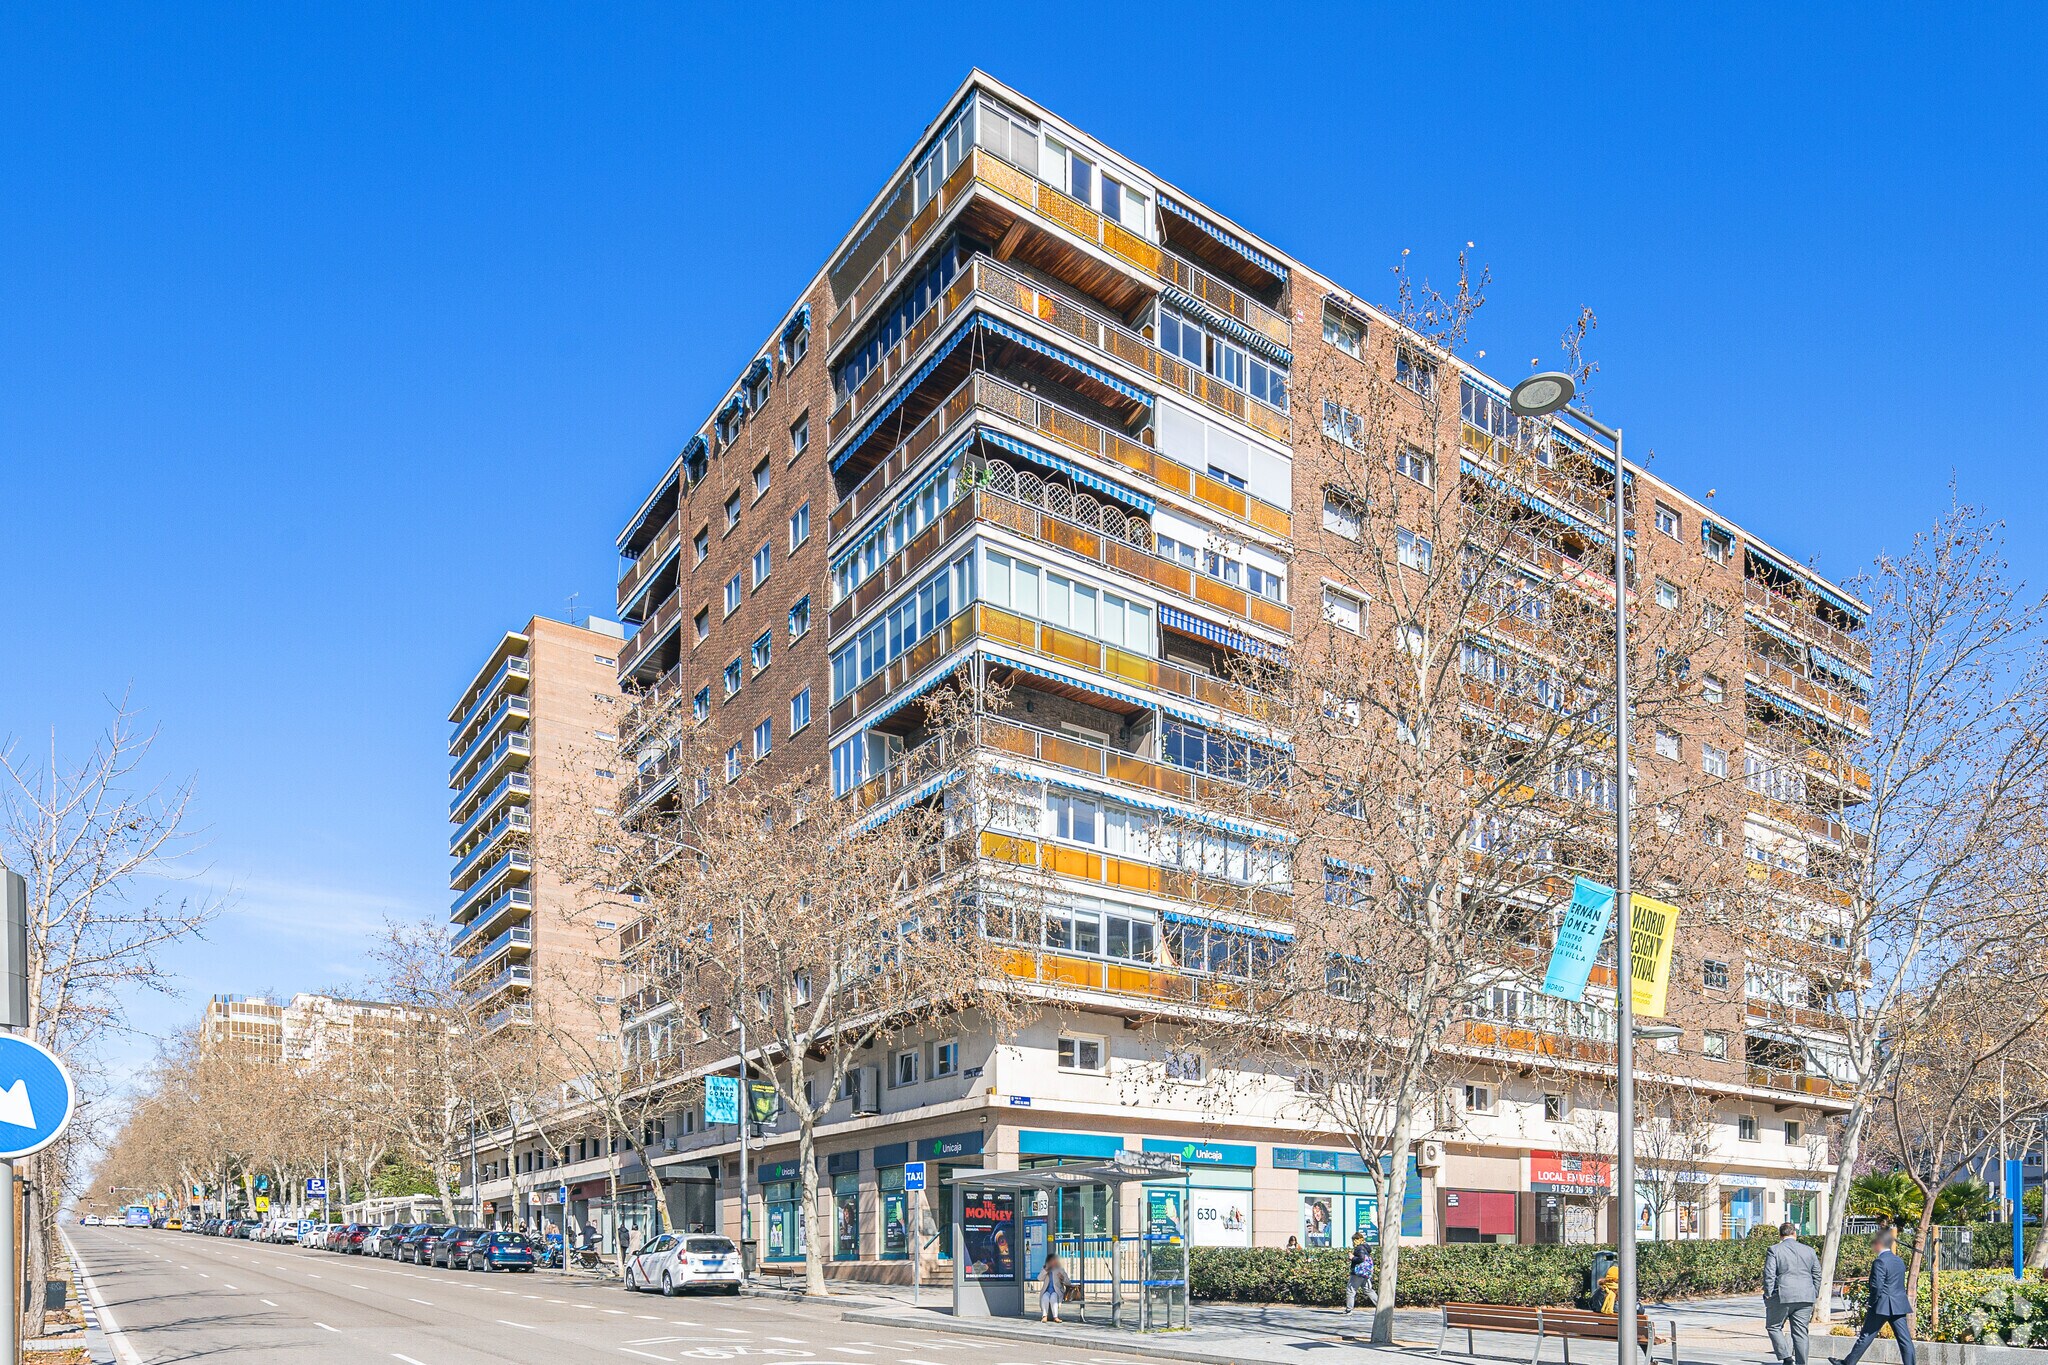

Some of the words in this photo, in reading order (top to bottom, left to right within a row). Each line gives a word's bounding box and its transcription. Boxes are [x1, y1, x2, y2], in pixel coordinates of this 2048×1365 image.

[1570, 902, 1602, 922] ERNÁN
[1630, 931, 1656, 957] ESIGN
[942, 1142, 962, 1154] Unicaja
[1195, 1149, 1223, 1162] Unicaja
[781, 1167, 796, 1177] Unicaja
[906, 1171, 924, 1182] TAXI
[1537, 1170, 1565, 1182] LOCAL
[1567, 1172, 1579, 1183] EN
[311, 1180, 322, 1190] P
[1551, 1184, 1560, 1193] 91
[1560, 1185, 1575, 1194] 524
[982, 1200, 997, 1211] THE
[965, 1207, 1013, 1221] MONKEY
[1197, 1208, 1217, 1221] 630
[300, 1221, 312, 1234] P
